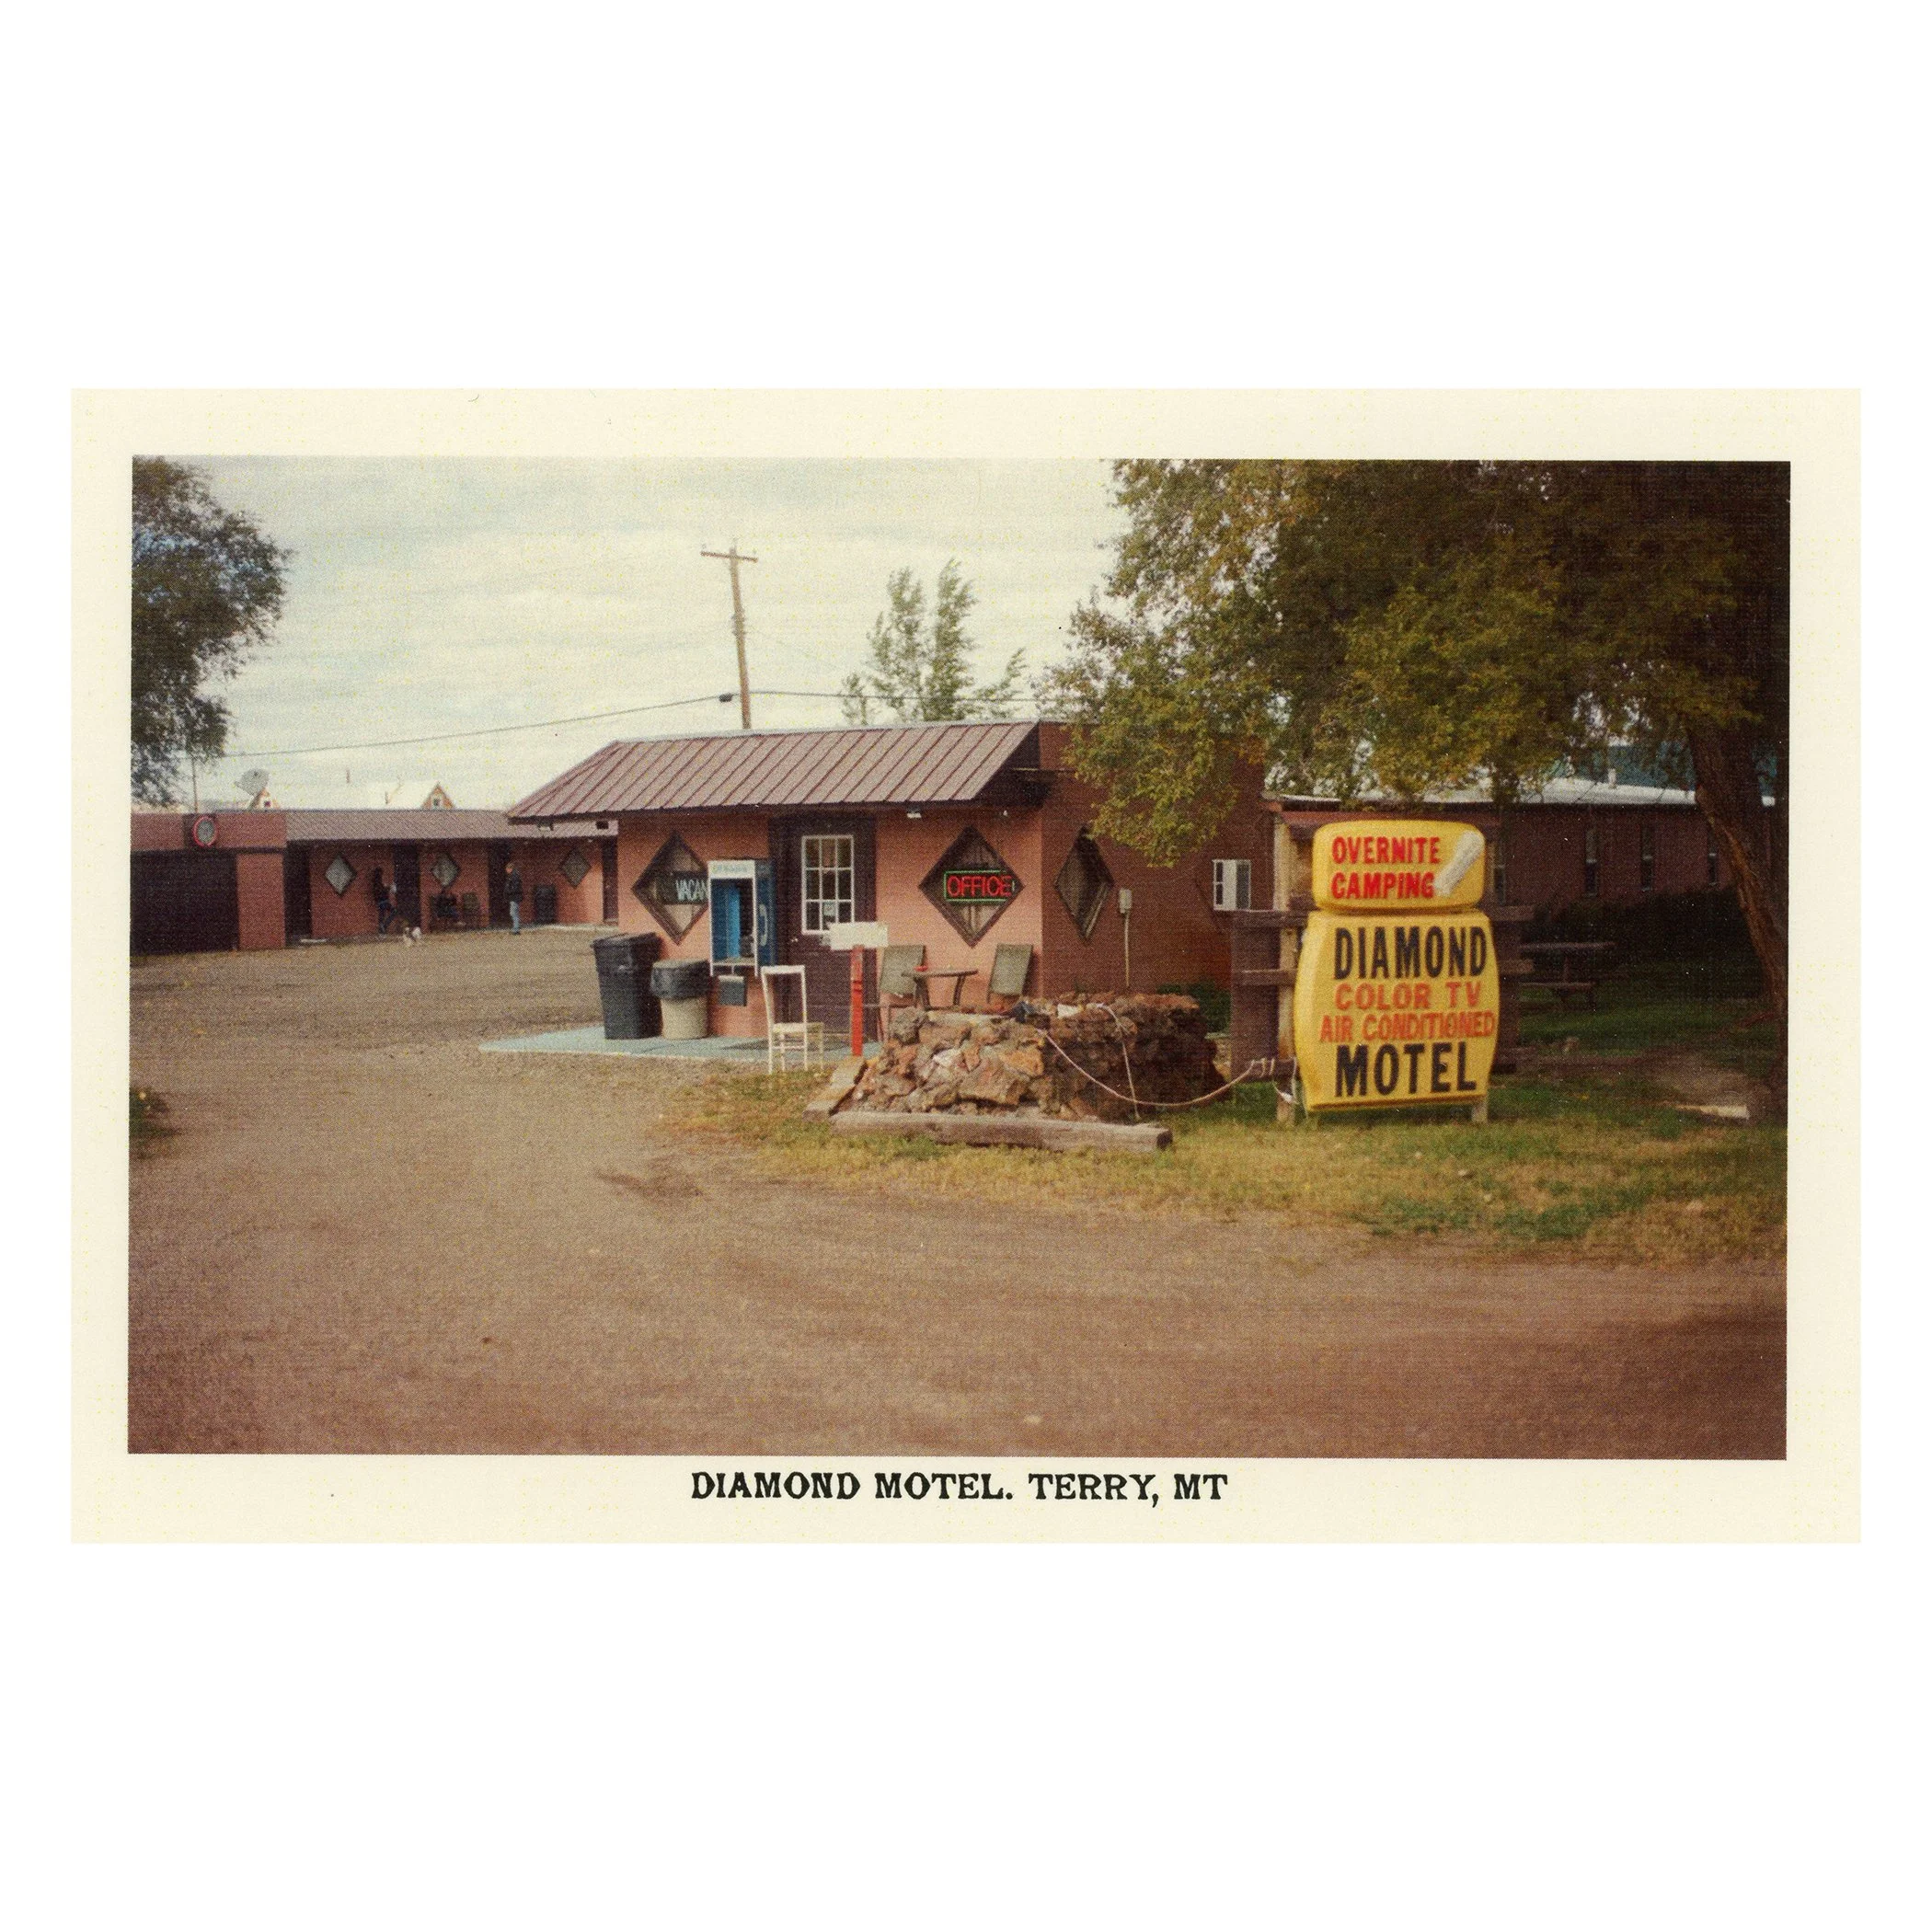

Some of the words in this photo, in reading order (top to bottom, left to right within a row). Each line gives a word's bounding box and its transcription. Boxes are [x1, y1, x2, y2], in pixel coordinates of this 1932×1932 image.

[1331, 836, 1442, 865] OVERNITE
[947, 875, 1012, 897] OFFICE
[1330, 871, 1435, 899] CAMPING
[1334, 926, 1487, 980] DIAMOND
[1334, 982, 1432, 1010] COLOR
[1445, 981, 1482, 1007] TV
[1320, 1015, 1353, 1042] AIR
[1362, 1011, 1495, 1041] CONDITIONED
[1335, 1041, 1477, 1097] MOTEL
